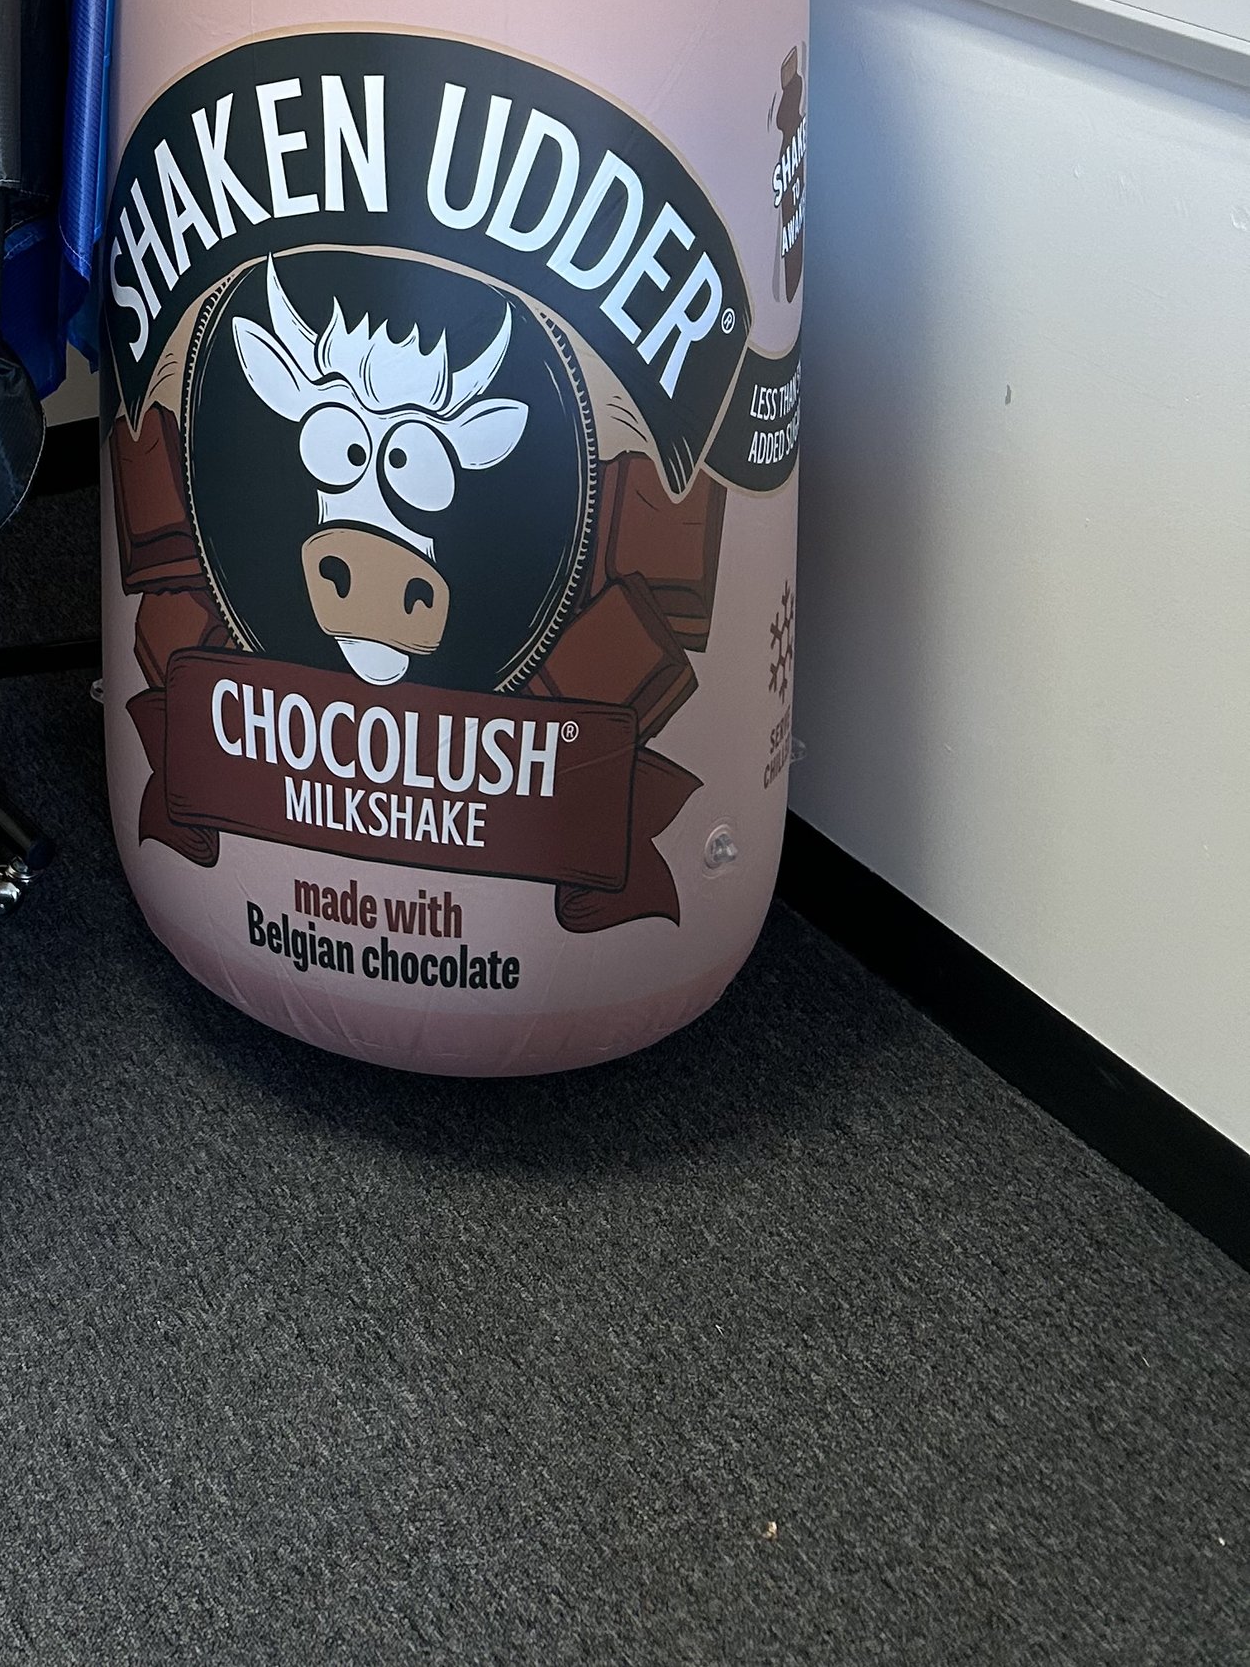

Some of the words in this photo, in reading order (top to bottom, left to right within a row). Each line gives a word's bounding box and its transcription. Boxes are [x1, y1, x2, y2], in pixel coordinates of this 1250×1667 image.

[109, 74, 388, 362] SHAKEN
[750, 384, 778, 421] LESS
[779, 372, 797, 418] THAN
[747, 429, 786, 464] ADDED
[283, 775, 488, 848] MILKSHAKE
[293, 877, 378, 928] made
[384, 891, 463, 939] with
[246, 900, 354, 975] Belgian
[361, 934, 521, 991] chocolate
